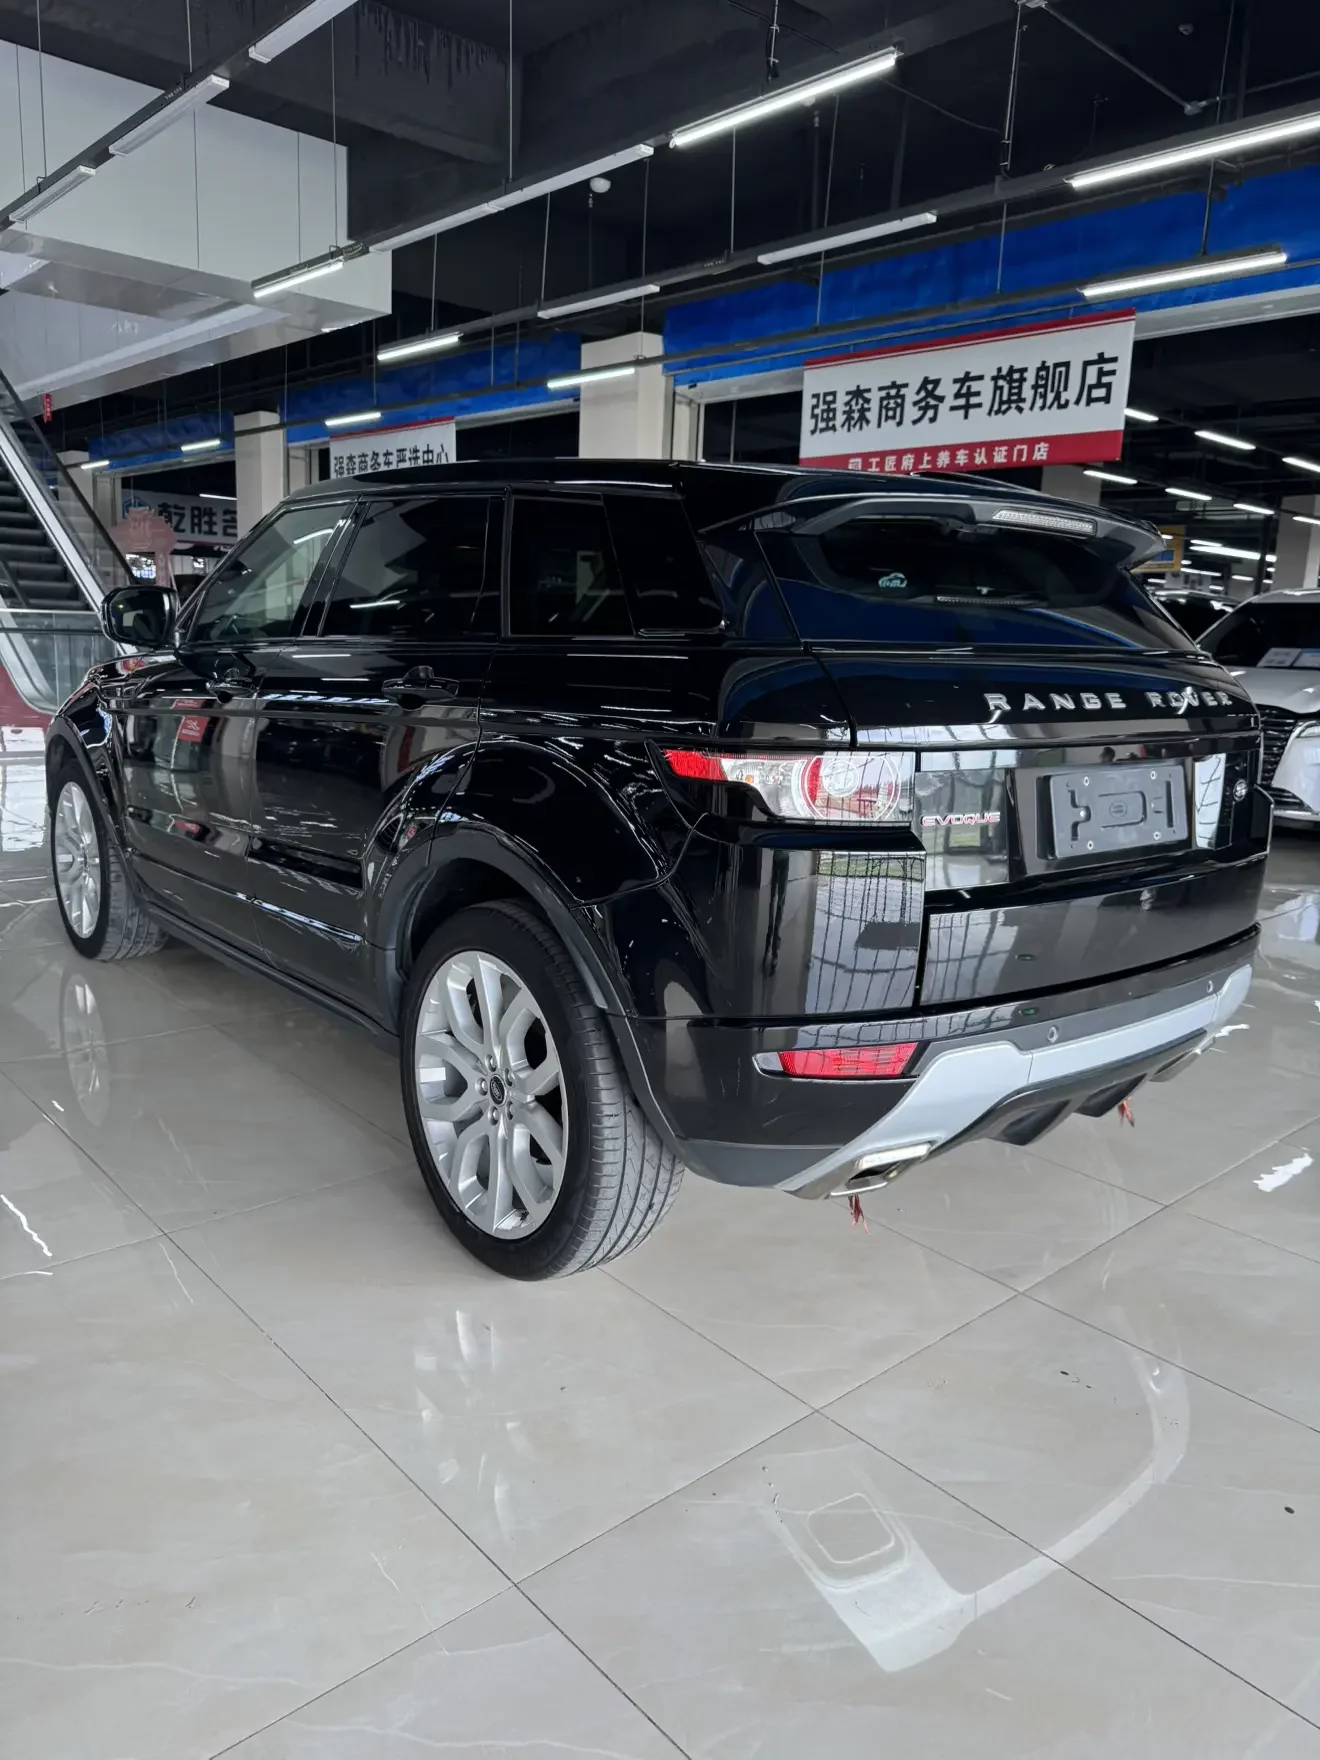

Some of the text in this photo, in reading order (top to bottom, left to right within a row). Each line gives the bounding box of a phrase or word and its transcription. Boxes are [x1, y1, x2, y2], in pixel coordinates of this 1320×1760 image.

[809, 352, 1119, 436] 强森商务车旗舰店
[983, 691, 1233, 711] RANGE ROVER
[921, 811, 1001, 827] EVOQUE
